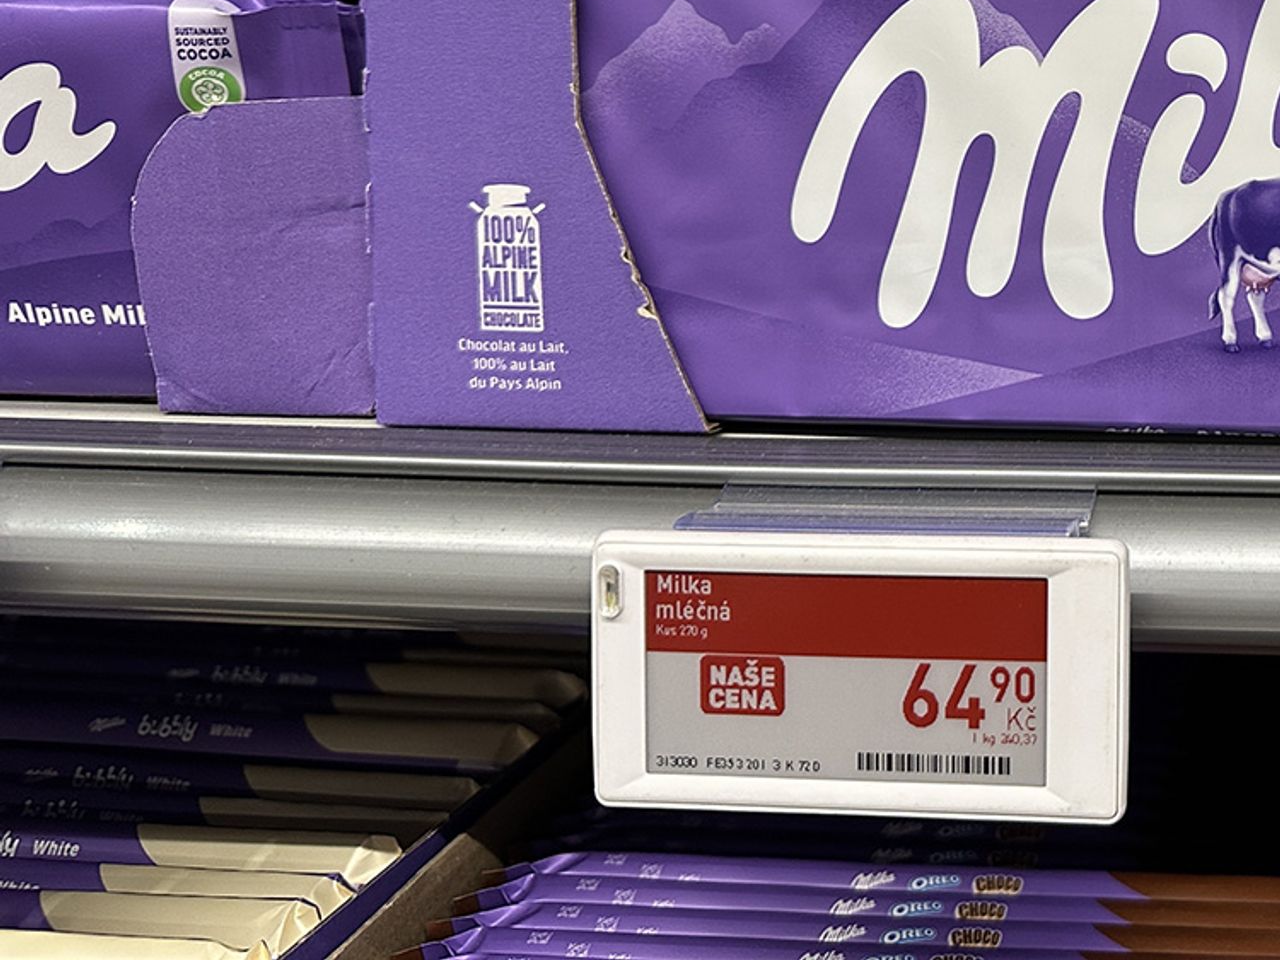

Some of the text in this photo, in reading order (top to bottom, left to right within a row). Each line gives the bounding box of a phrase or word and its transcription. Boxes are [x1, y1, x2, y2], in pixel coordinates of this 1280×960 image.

[174, 26, 228, 36] SUSTAINABLY
[175, 37, 230, 47] SOURCED
[177, 48, 233, 60] COCOA
[188, 68, 225, 80] COCOA
[483, 215, 535, 243] 100%
[482, 245, 538, 269] ALPINE
[482, 270, 539, 302] MILK
[8, 302, 147, 327] Alpine Mil
[483, 312, 541, 328] CHOCOLATE
[458, 338, 516, 352] Chocolat
[519, 341, 536, 352] au
[472, 358, 555, 371] 100% au Lait
[469, 376, 562, 391] du Pays Alpin
[656, 574, 712, 595] Milka
[655, 599, 731, 621] mléčná
[656, 624, 708, 639] Kus 270 g
[709, 659, 776, 687] NAŠE
[708, 688, 777, 710] CENA
[902, 663, 1036, 730] 64 90
[1007, 706, 1037, 731] Kč
[209, 722, 253, 739] White
[983, 733, 996, 747] kg
[656, 755, 698, 768] 313030
[32, 839, 81, 857] White
[850, 870, 1023, 893] Milka OREO CHOCO
[829, 897, 1007, 919] Milka OREO CHOCO
[818, 925, 1001, 946] Milka OREO CHOCO
